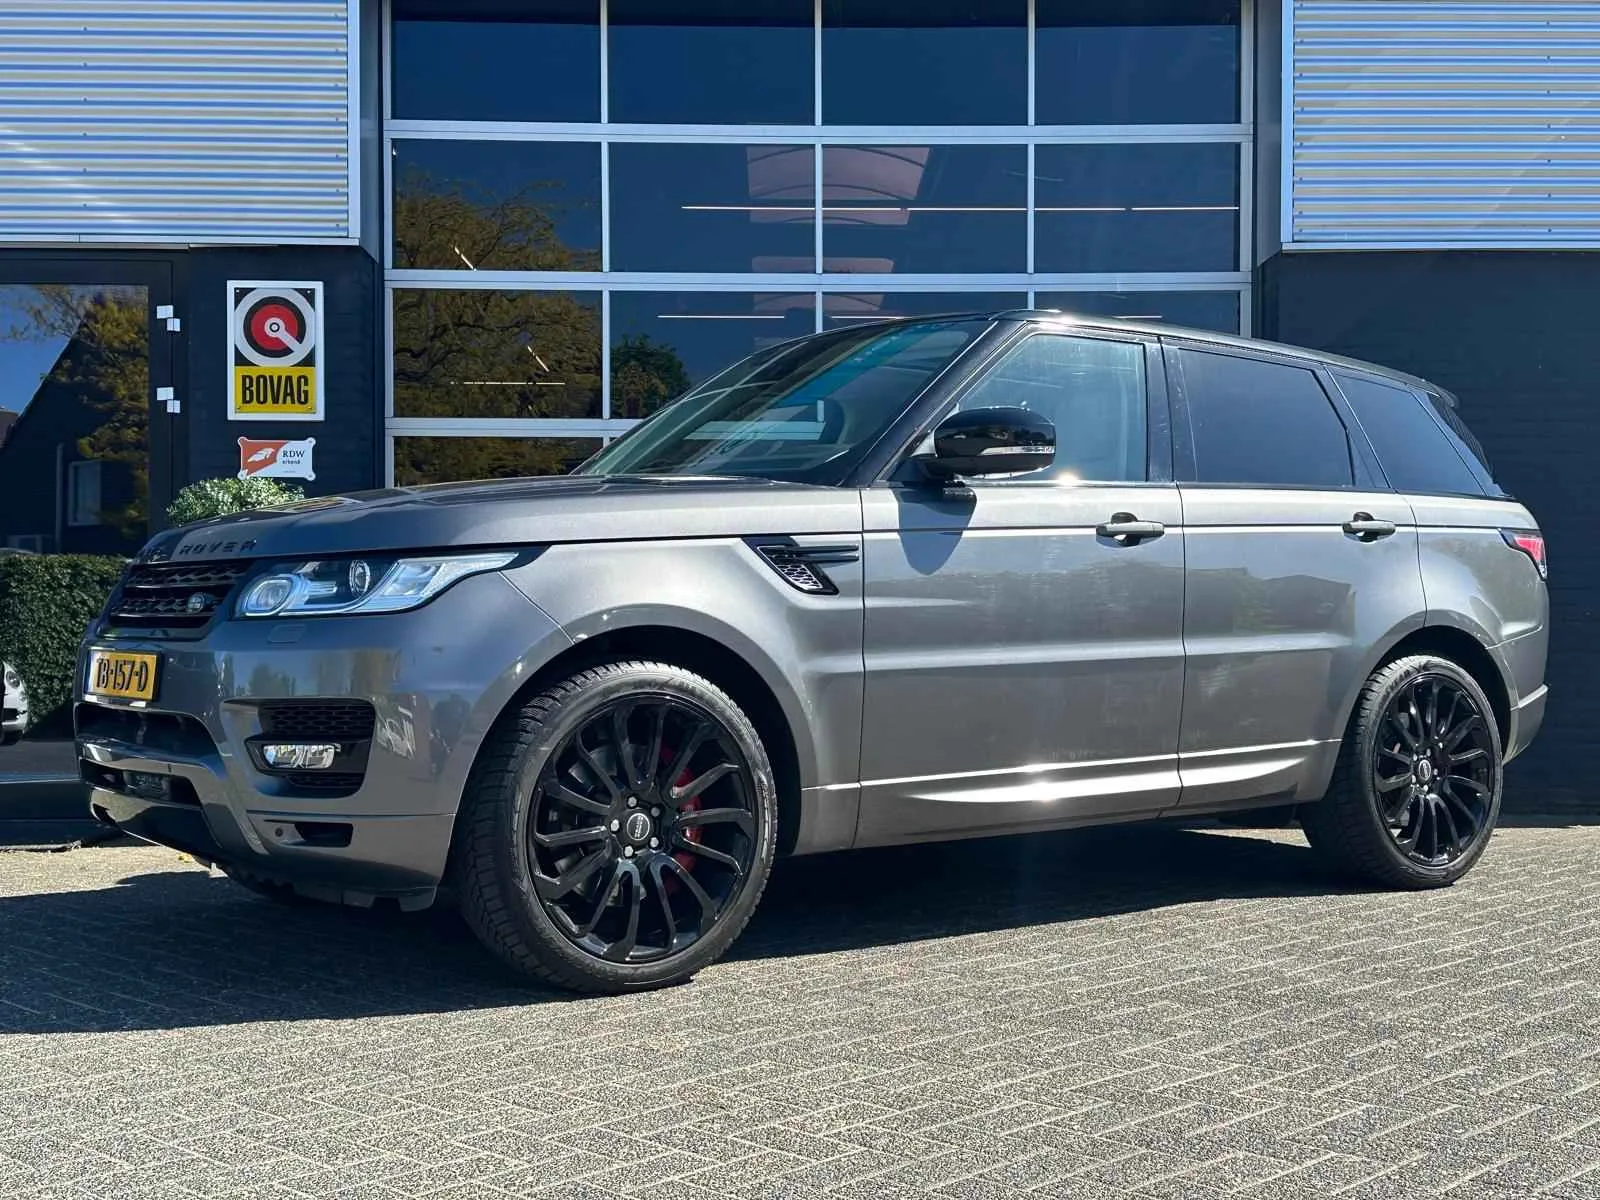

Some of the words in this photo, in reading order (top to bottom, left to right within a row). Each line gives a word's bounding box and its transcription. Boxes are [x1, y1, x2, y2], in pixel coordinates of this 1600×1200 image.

[241, 374, 309, 405] BOVAG
[282, 450, 305, 458] RDW
[179, 539, 257, 555] ROVER
[96, 657, 149, 692] TB-157-D
